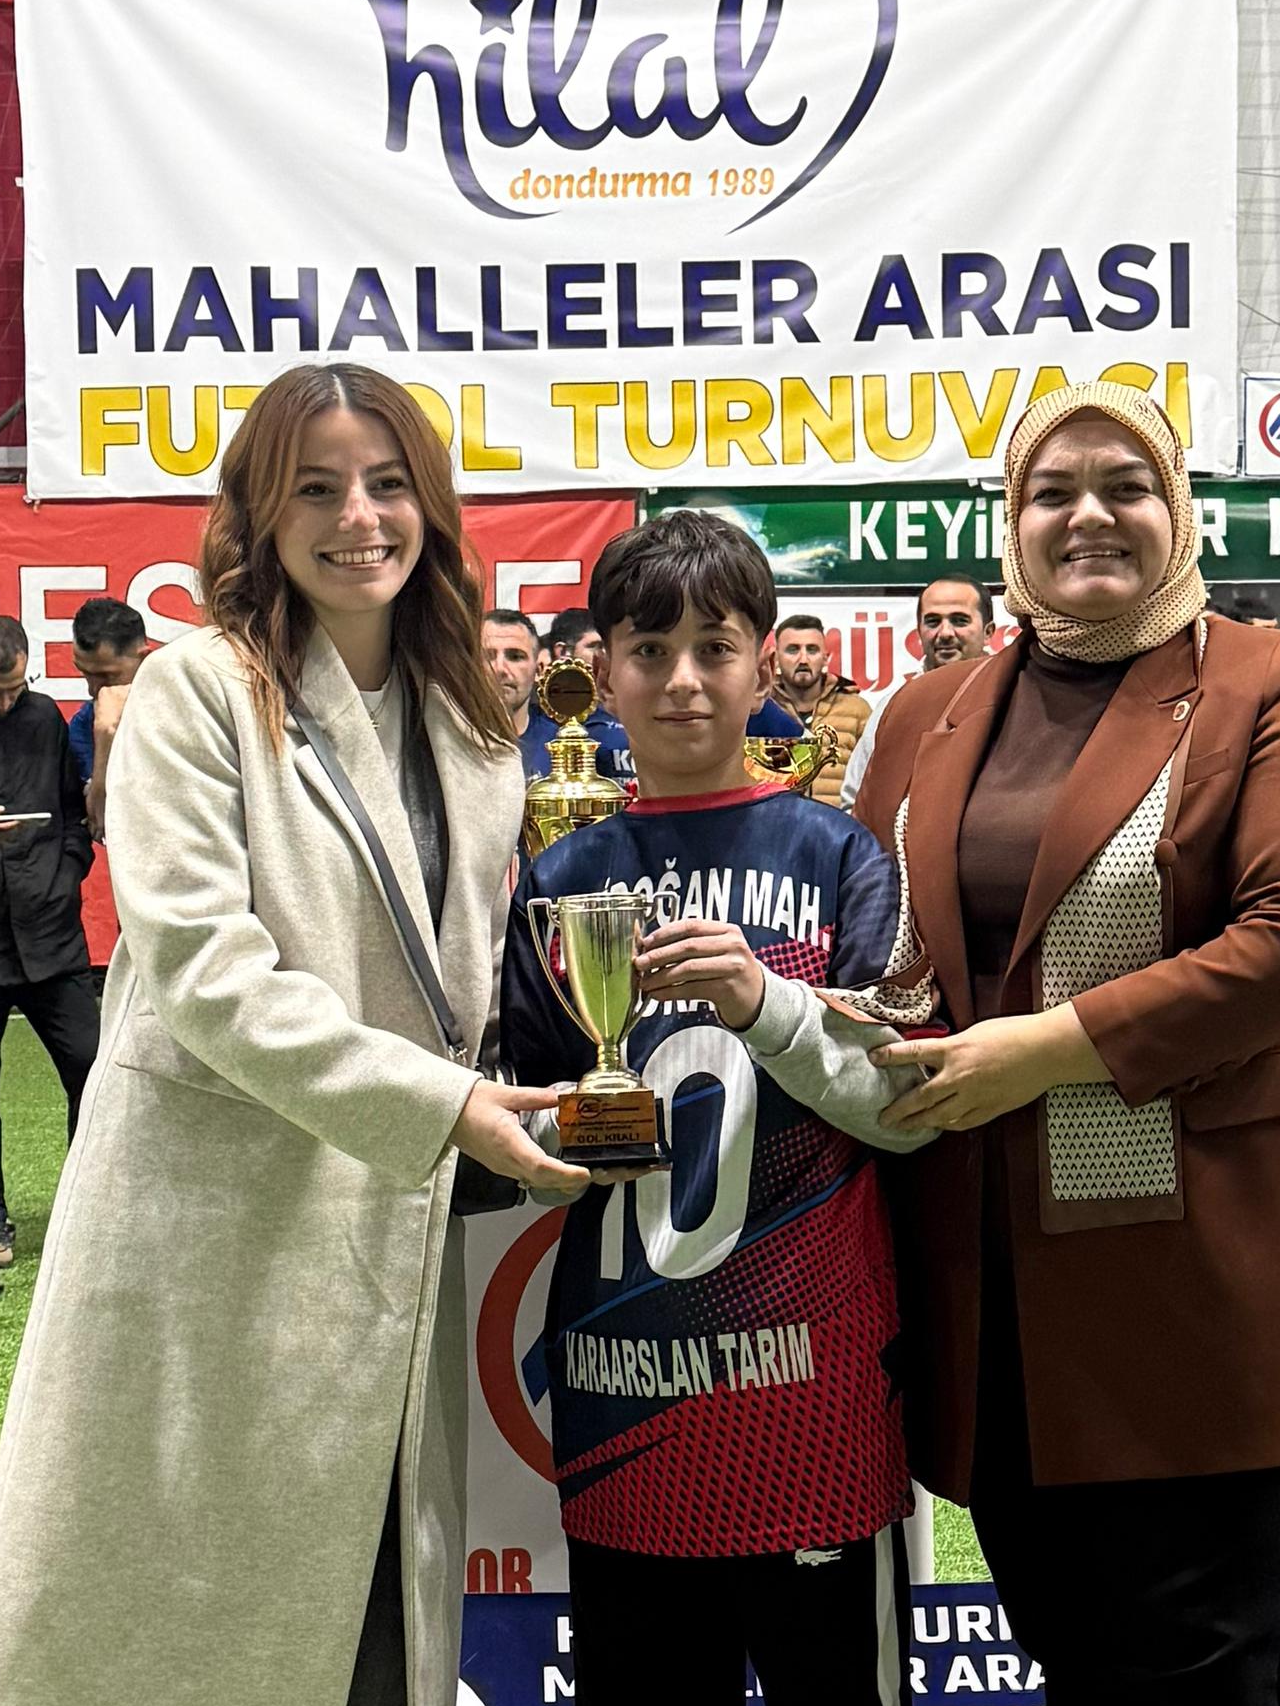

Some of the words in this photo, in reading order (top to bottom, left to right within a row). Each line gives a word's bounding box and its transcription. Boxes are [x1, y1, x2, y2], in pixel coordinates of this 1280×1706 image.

[509, 166, 691, 199] dondurma
[708, 166, 775, 197] 1989
[75, 258, 822, 354] MAHALLELER
[854, 242, 1191, 342] ARASI
[80, 382, 522, 476] FUL
[566, 1330, 714, 1397] KARAARSLAN
[719, 1321, 815, 1392] TARIM
